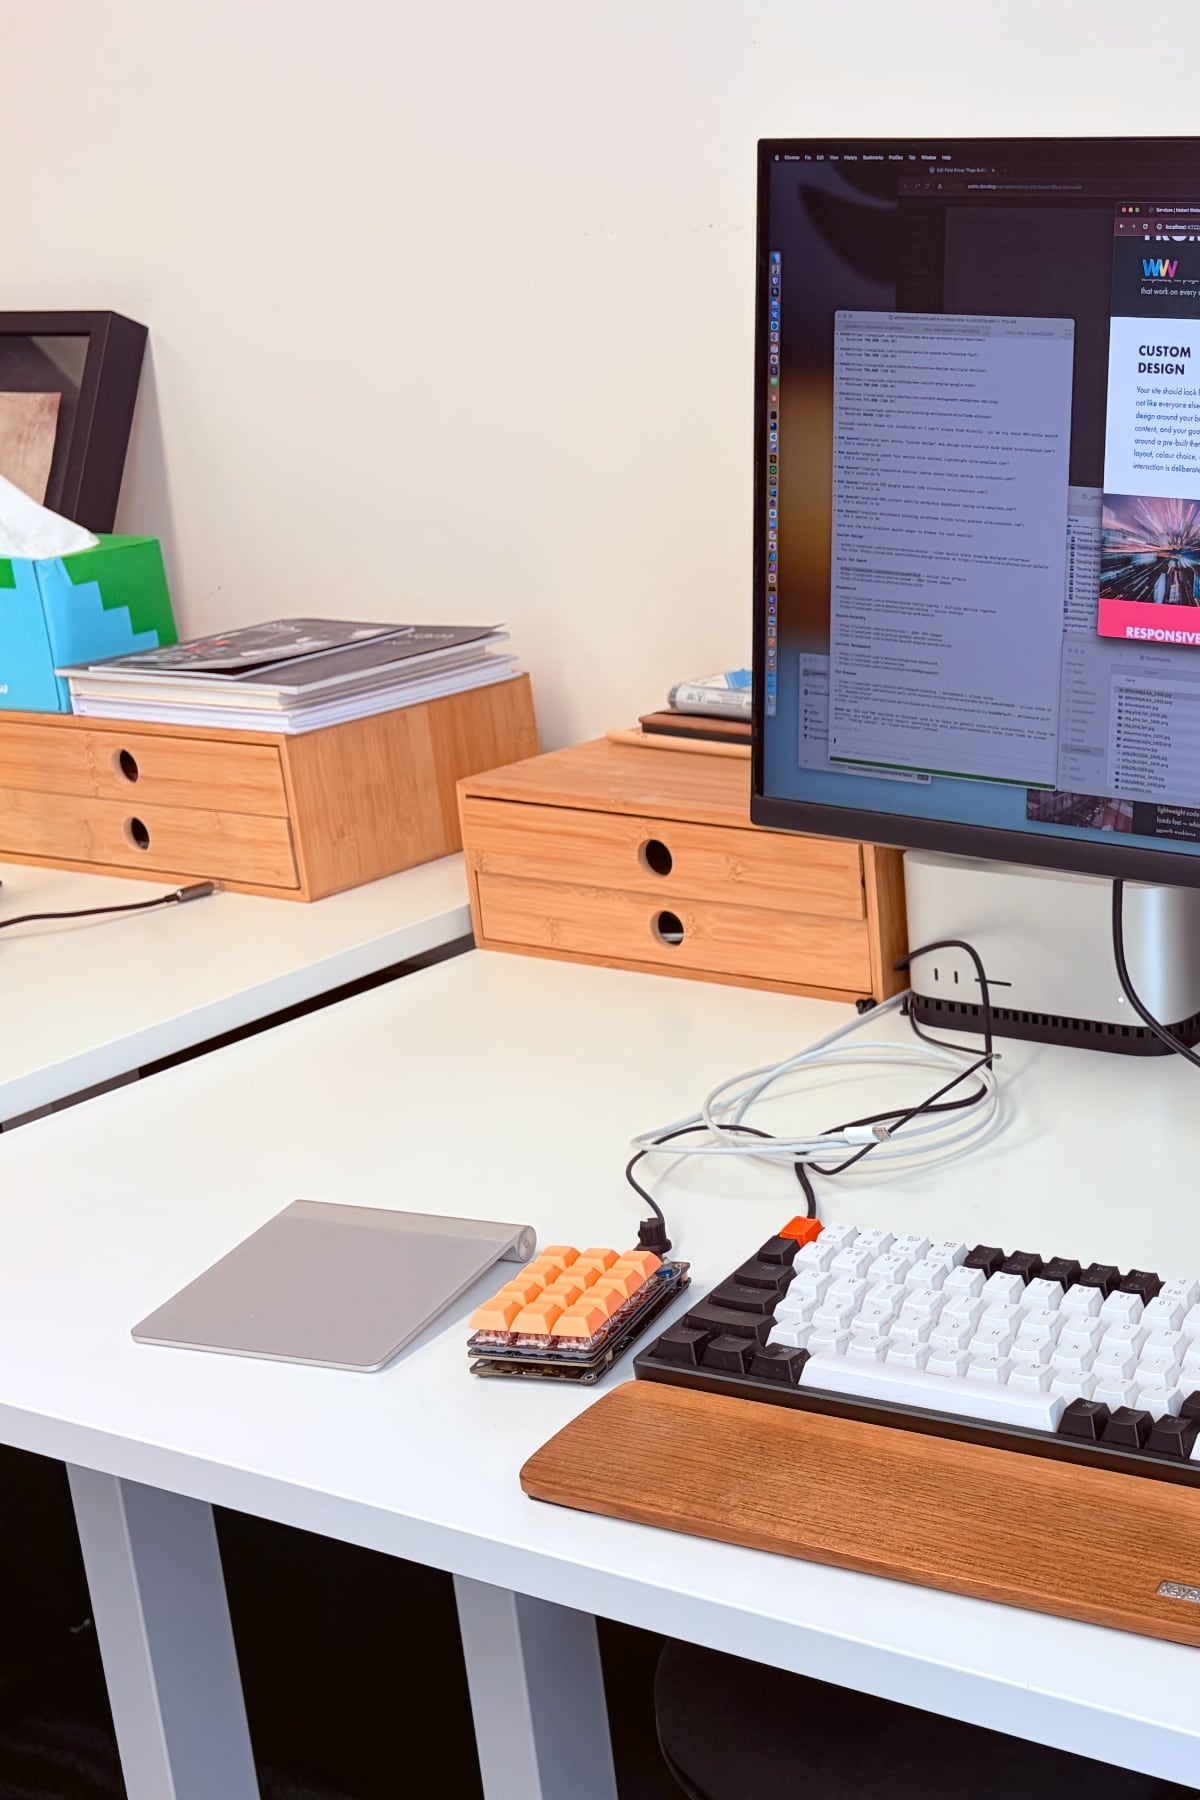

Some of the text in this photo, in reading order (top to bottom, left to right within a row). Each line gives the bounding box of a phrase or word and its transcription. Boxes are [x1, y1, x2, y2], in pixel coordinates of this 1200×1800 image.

[1141, 286, 1153, 295] that
[1139, 345, 1191, 358] CUSTOM
[1138, 362, 1185, 375] DESIGN
[1136, 386, 1150, 394] Your
[1163, 387, 1183, 396] should
[1184, 388, 1197, 396] look
[1147, 399, 1157, 407] like
[1158, 402, 1187, 410] everyone
[1136, 412, 1156, 422] design
[1134, 426, 1158, 434] content,
[1160, 426, 1172, 434] and
[1162, 438, 1188, 448] pre-built
[1134, 449, 1154, 459] layout,
[1176, 452, 1198, 461] choice,
[1133, 463, 1164, 471] interaction
[1157, 806, 1186, 817] lightweight
[1156, 816, 1172, 824] loads
